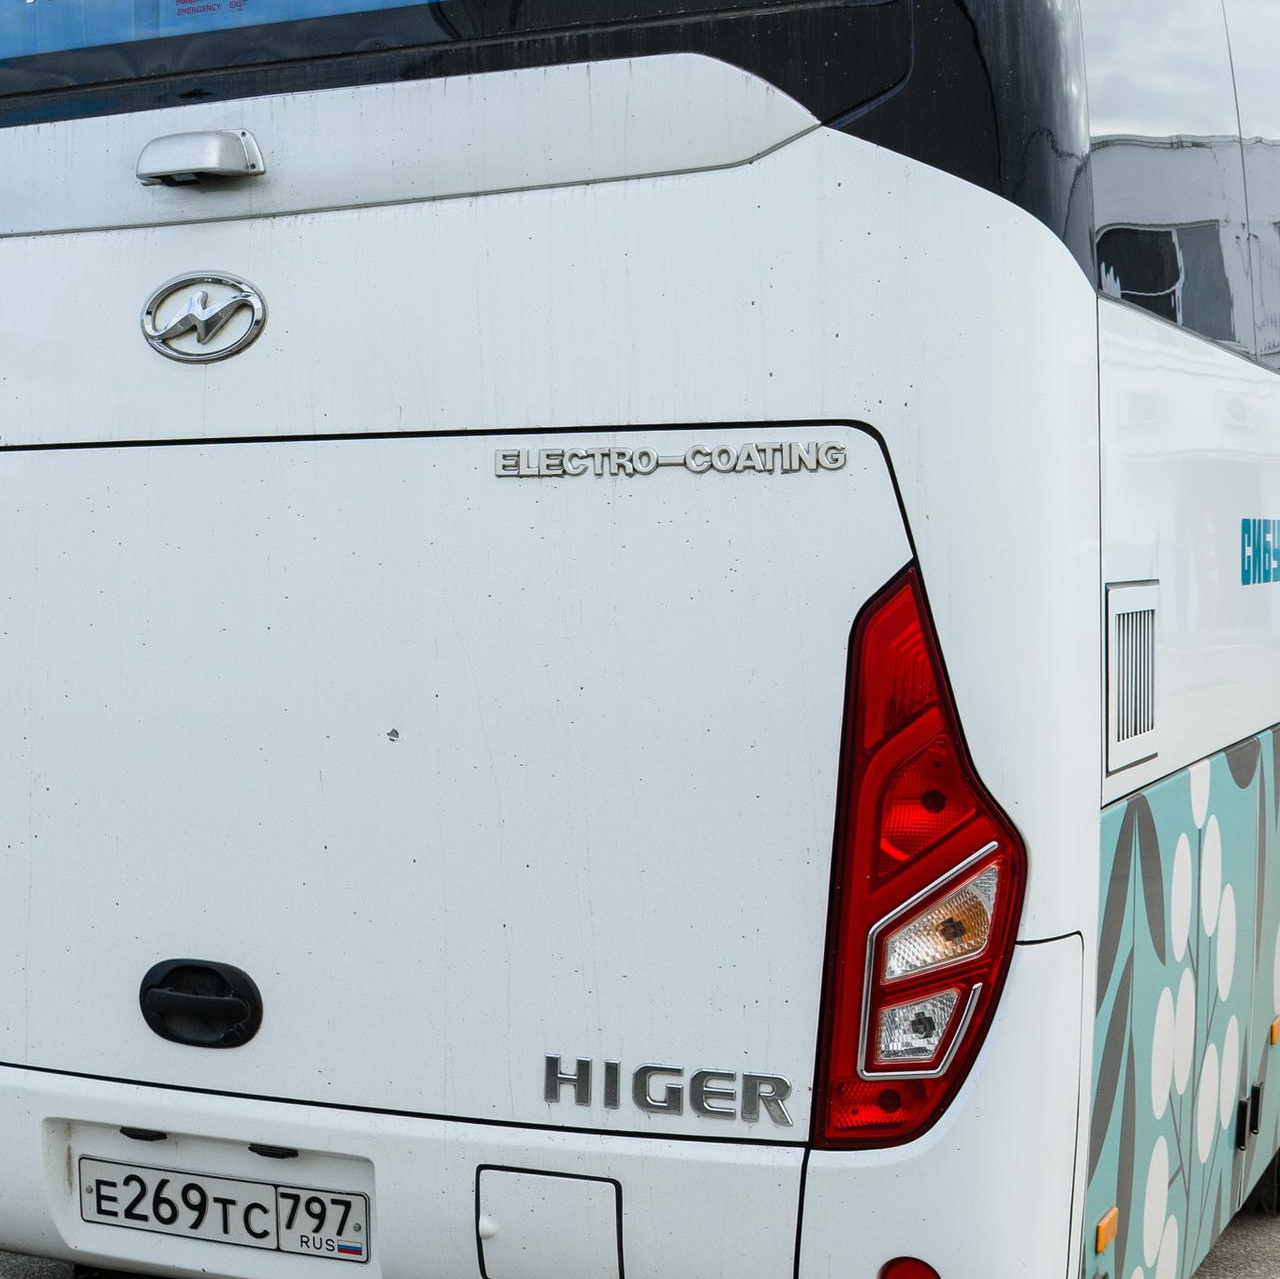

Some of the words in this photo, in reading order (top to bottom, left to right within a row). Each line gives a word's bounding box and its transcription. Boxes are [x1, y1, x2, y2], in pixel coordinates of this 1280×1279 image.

[176, 3, 220, 15] EMERGENCY
[229, 0, 248, 9] EXIT
[495, 440, 847, 479] ELECTRO-COATING
[544, 1053, 794, 1126] HIGER
[279, 1192, 352, 1237] 797
[300, 1234, 337, 1252] RUS
